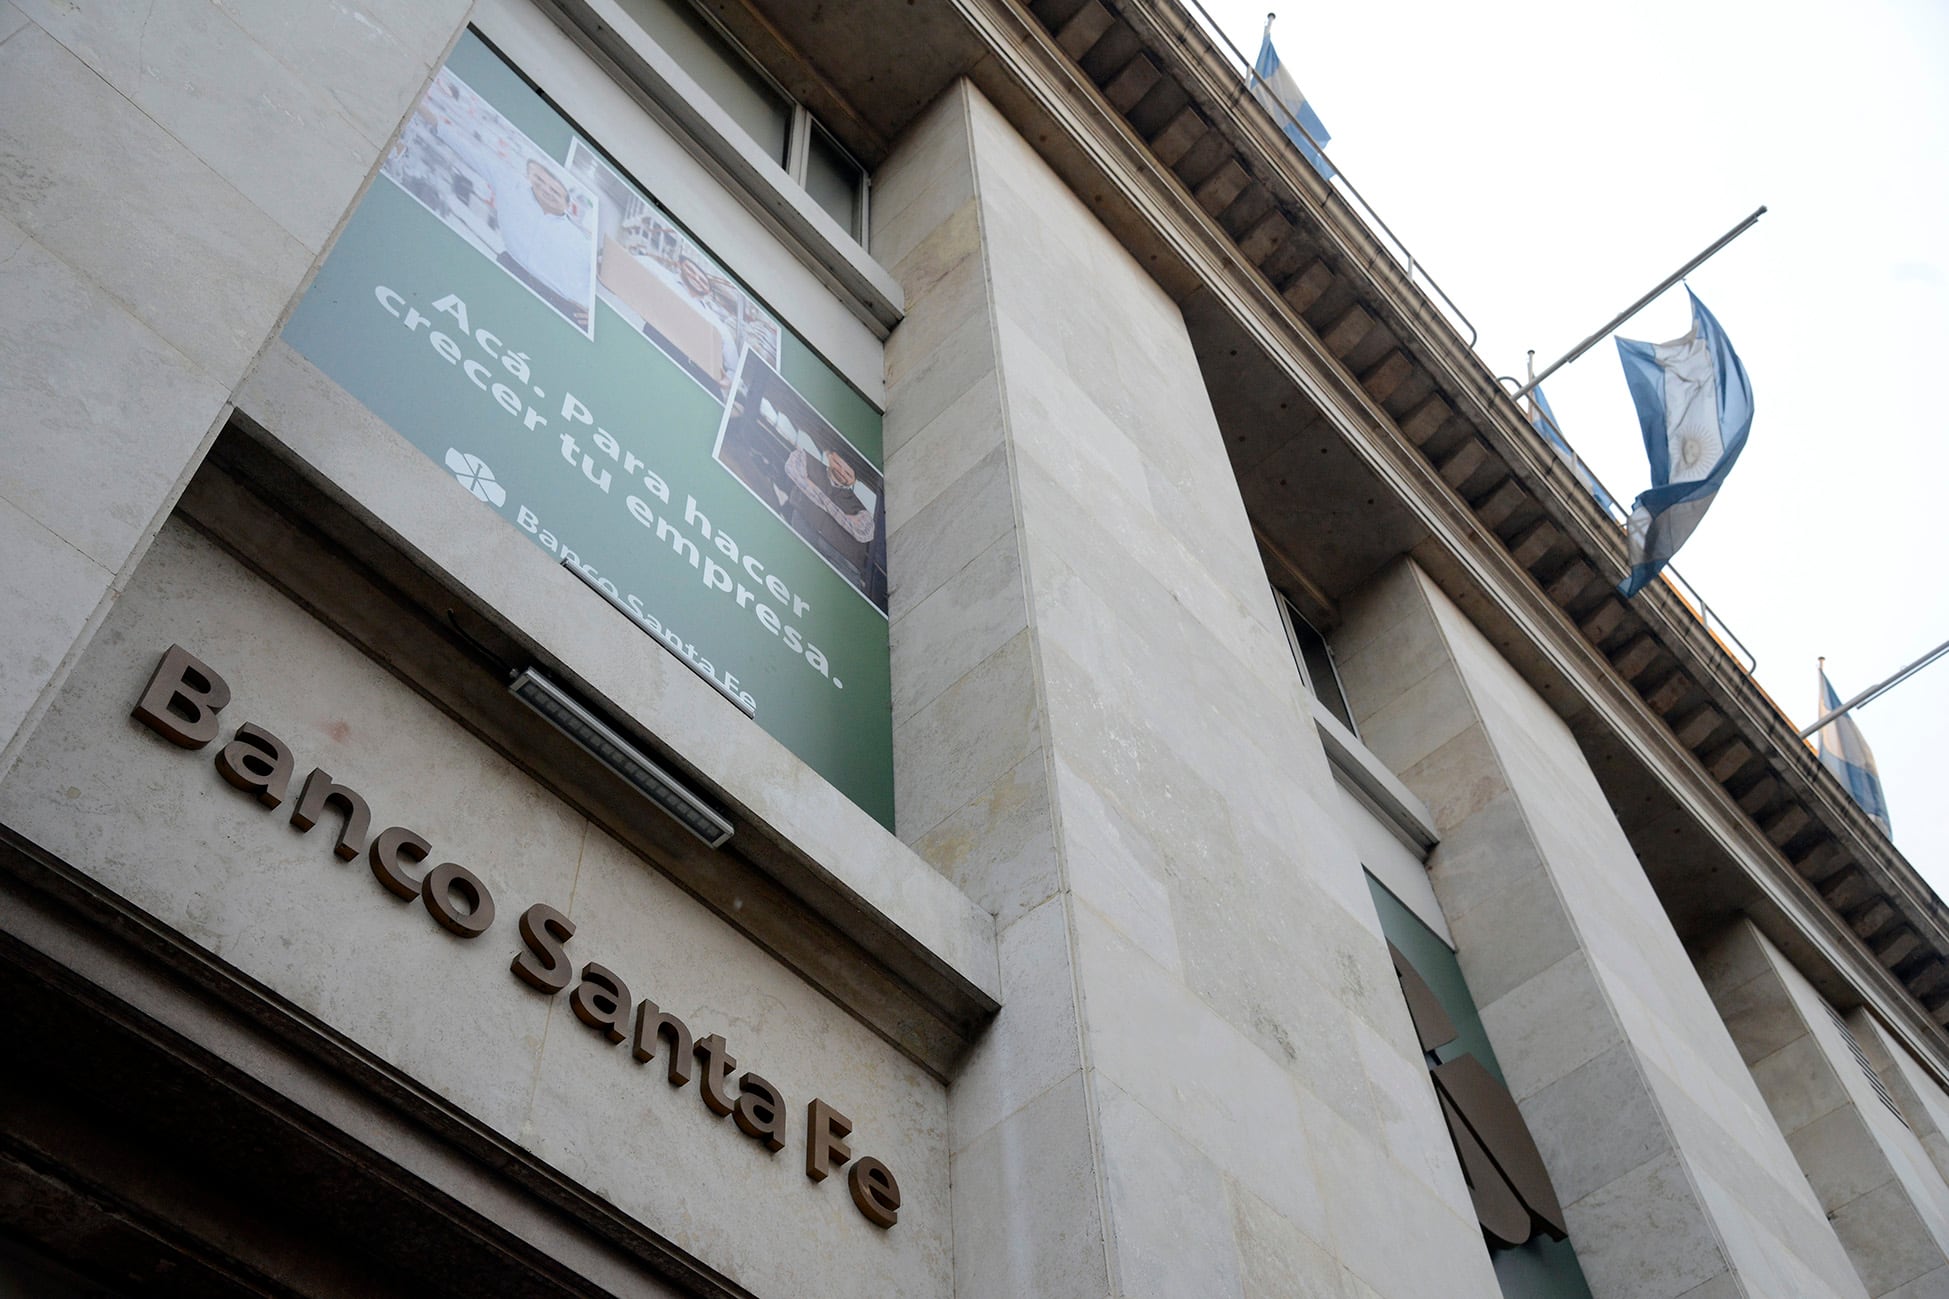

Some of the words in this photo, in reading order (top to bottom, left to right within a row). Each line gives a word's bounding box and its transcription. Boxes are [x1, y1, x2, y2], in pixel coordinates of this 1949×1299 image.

[375, 285, 548, 432] crecer
[559, 432, 613, 495] tu
[626, 495, 844, 691] empresa.
[432, 293, 545, 399] Acá.
[561, 392, 671, 505] Para
[684, 495, 811, 619] hacer
[131, 644, 496, 939] Banco
[510, 903, 788, 1153] Santa
[806, 1097, 902, 1230] Fe
